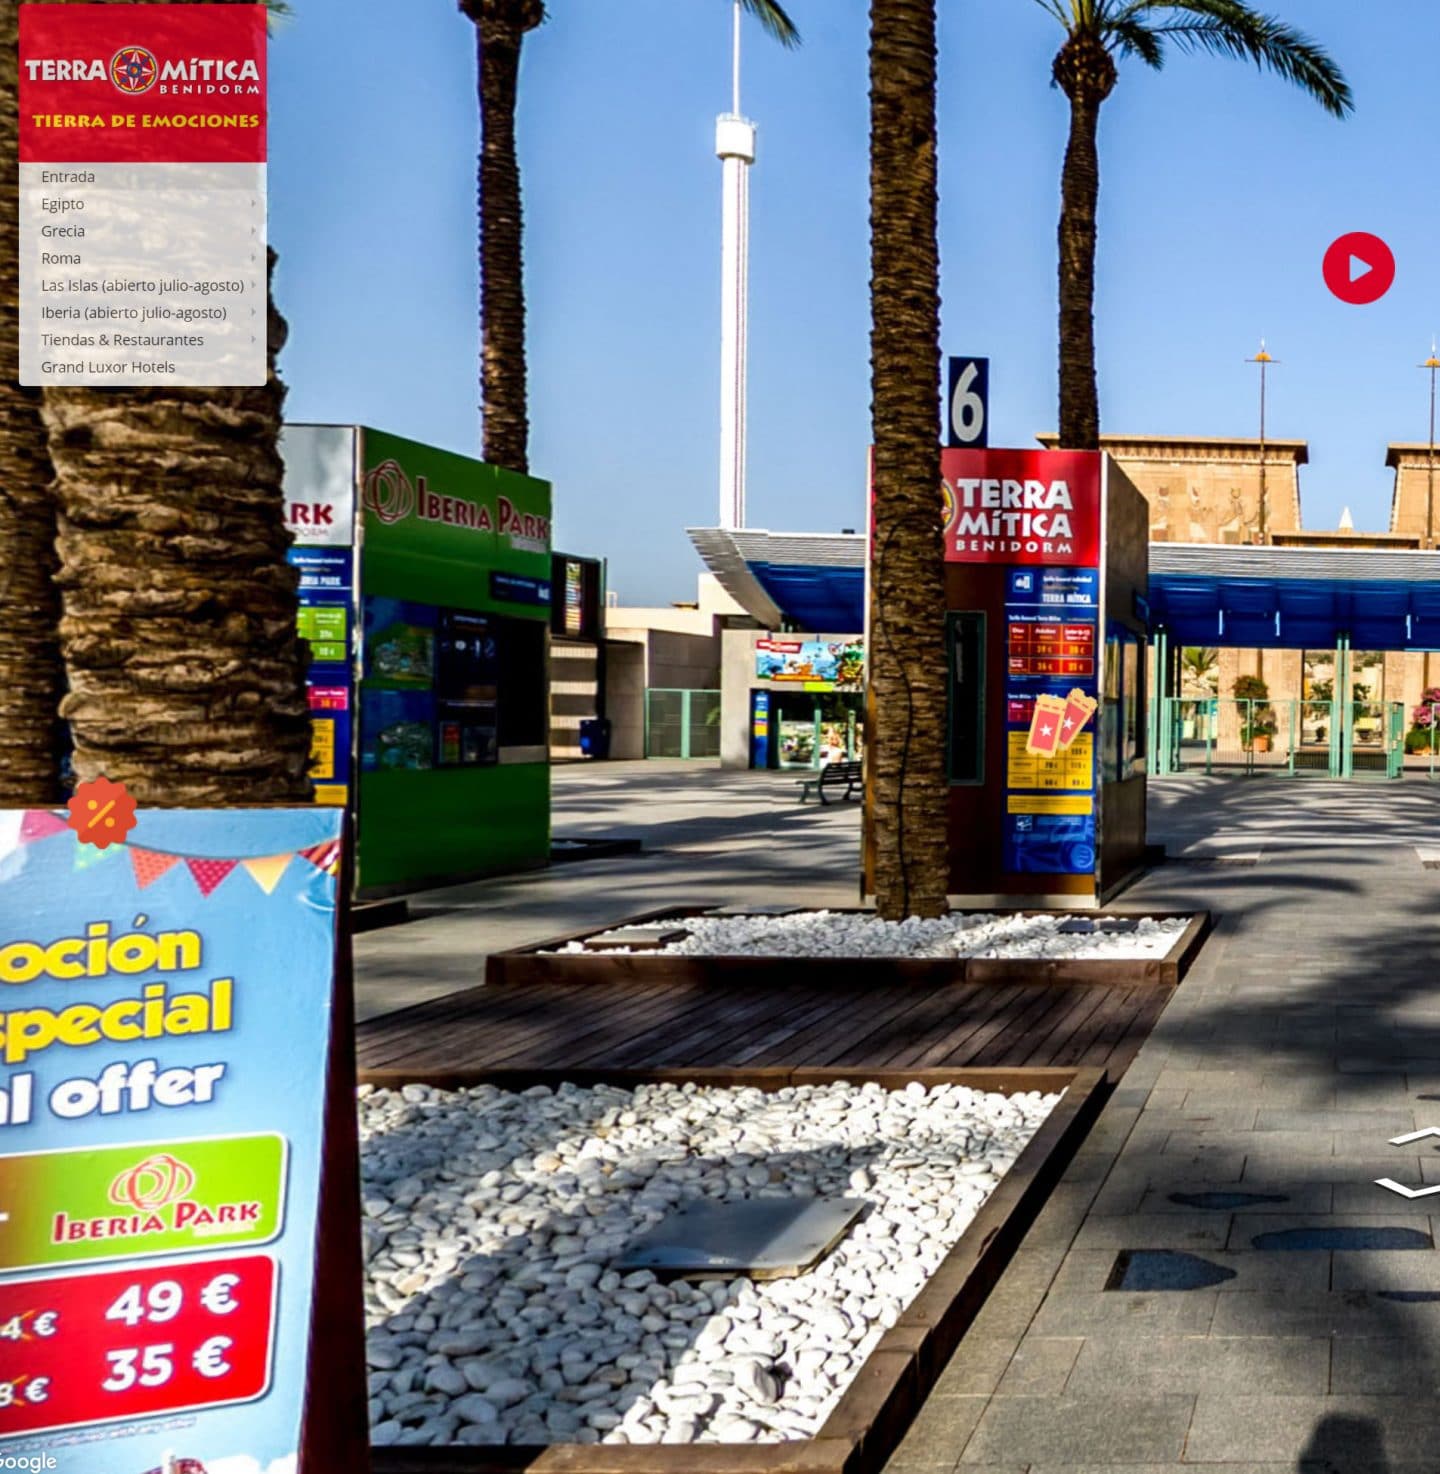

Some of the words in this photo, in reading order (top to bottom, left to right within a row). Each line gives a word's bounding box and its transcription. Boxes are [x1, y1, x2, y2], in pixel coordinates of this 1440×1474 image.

[951, 361, 984, 443] 6
[284, 502, 333, 525] RK
[415, 475, 493, 532] IBERIA
[496, 495, 549, 540] PARK
[956, 478, 1073, 510] TERRA
[956, 540, 1073, 554] BENIDORM
[0, 976, 234, 1064] pecial
[49, 1058, 227, 1120] offer
[53, 1213, 164, 1242] IBERIA
[174, 1201, 260, 1229] PARK
[104, 1280, 184, 1327] 49
[201, 1272, 239, 1315] €
[101, 1343, 174, 1392] 35
[192, 1335, 232, 1378] €
